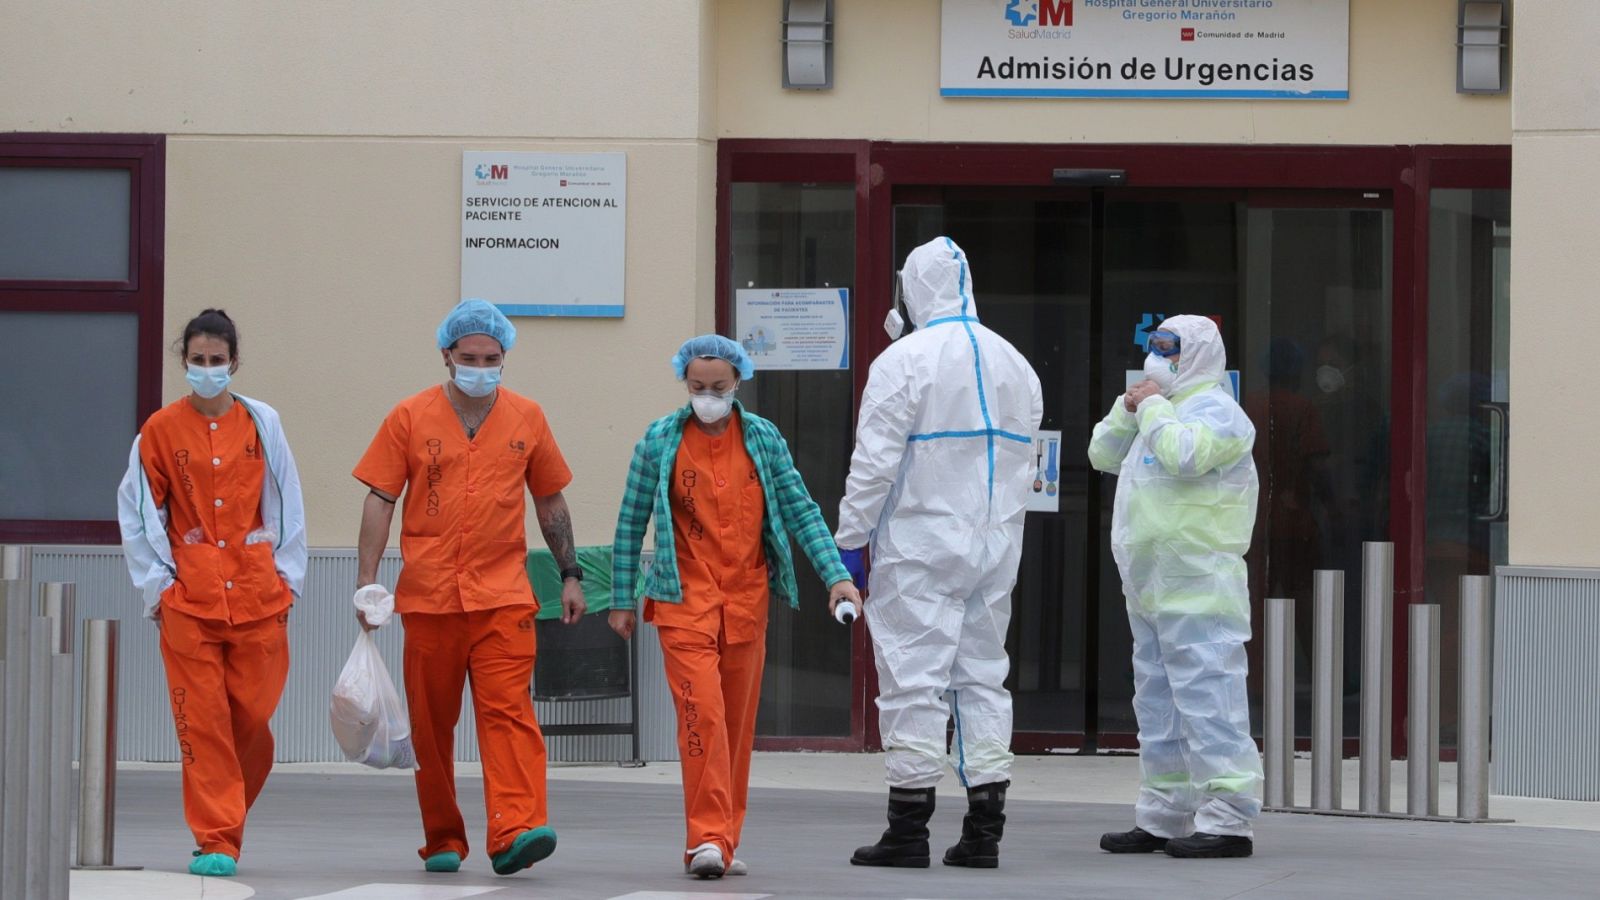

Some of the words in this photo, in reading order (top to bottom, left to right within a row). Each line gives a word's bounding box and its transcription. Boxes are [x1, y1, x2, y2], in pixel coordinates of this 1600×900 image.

[1122, 9, 1177, 22] Gregorio
[1180, 9, 1236, 21] Marañón
[1197, 30, 1241, 39] Comunidad
[1244, 31, 1254, 39] de
[1257, 31, 1285, 39] Madrid
[976, 55, 1112, 81] Admisión
[1120, 56, 1157, 81] de
[1164, 56, 1315, 84] Urgencias
[465, 197, 521, 208] SERVICIO
[523, 197, 539, 208] DE
[542, 198, 601, 208] ATENCION
[603, 198, 618, 208] AL
[465, 211, 522, 221] PACIENTE
[465, 237, 560, 249] INFORMACION
[426, 438, 442, 518] QUIROFANO
